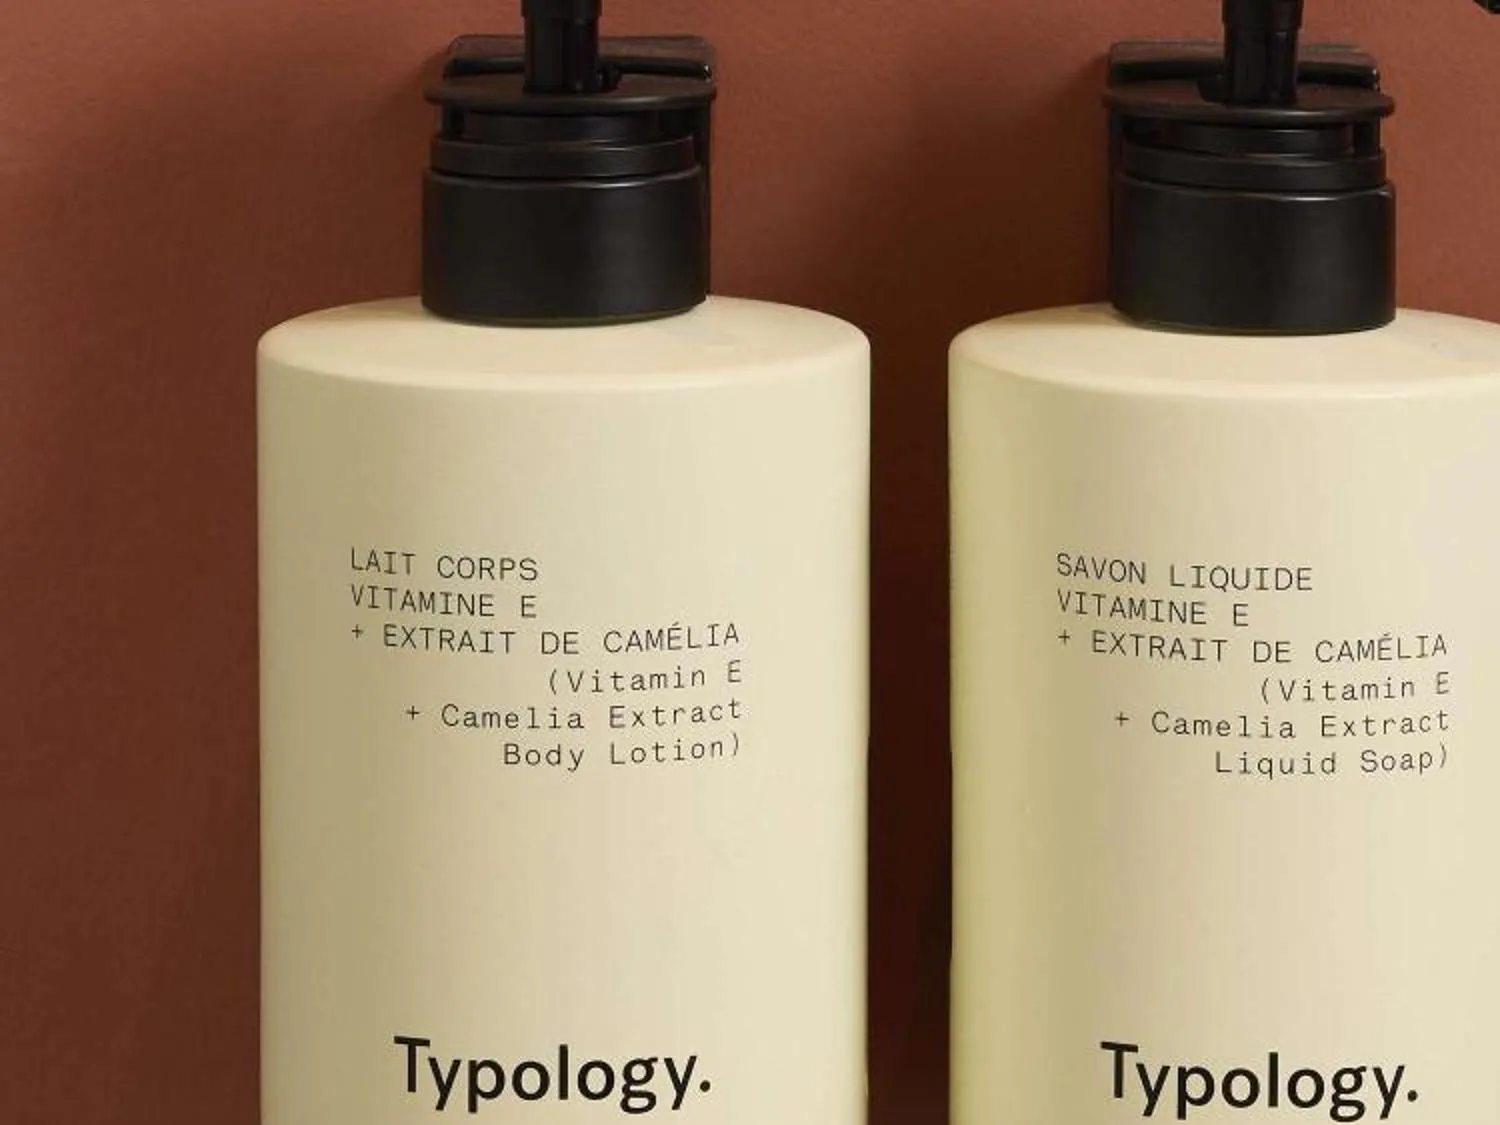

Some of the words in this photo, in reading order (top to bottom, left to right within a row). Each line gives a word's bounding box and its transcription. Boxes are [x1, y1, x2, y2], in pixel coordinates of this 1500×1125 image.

[351, 546, 417, 576] LAIT
[436, 554, 539, 582] CORPS
[1056, 552, 1147, 586] SAVON
[1169, 563, 1313, 593] LIQUIDE
[350, 583, 496, 618] VITAMINE
[520, 594, 537, 619] E
[1056, 587, 1207, 625] VITAMINE
[1232, 602, 1249, 628] E
[351, 623, 364, 639] +
[383, 623, 517, 655] EXTRAIT
[540, 630, 580, 656] DE
[602, 620, 740, 654] CAMÉLIA
[1057, 629, 1071, 645] +
[1091, 629, 1229, 663] EXTRAIT
[1252, 639, 1292, 664] DE
[1314, 631, 1448, 664] CAMÉLIA
[549, 664, 706, 696] (Vitamin
[727, 659, 742, 684] E
[1260, 675, 1415, 705] (Vitamin
[1435, 671, 1450, 695] E
[405, 705, 421, 721] +
[441, 703, 585, 730] Camelia
[608, 697, 742, 730] Extract
[1114, 711, 1130, 727] +
[1151, 710, 1297, 739] Camelia
[1320, 708, 1449, 738] Extract
[503, 742, 585, 774] Body
[609, 732, 741, 766] Lotion)
[1215, 750, 1337, 781] Liquid
[1359, 742, 1448, 776] Soap)
[394, 1035, 712, 1115] Typology.
[1099, 1040, 1419, 1124] Typology.
